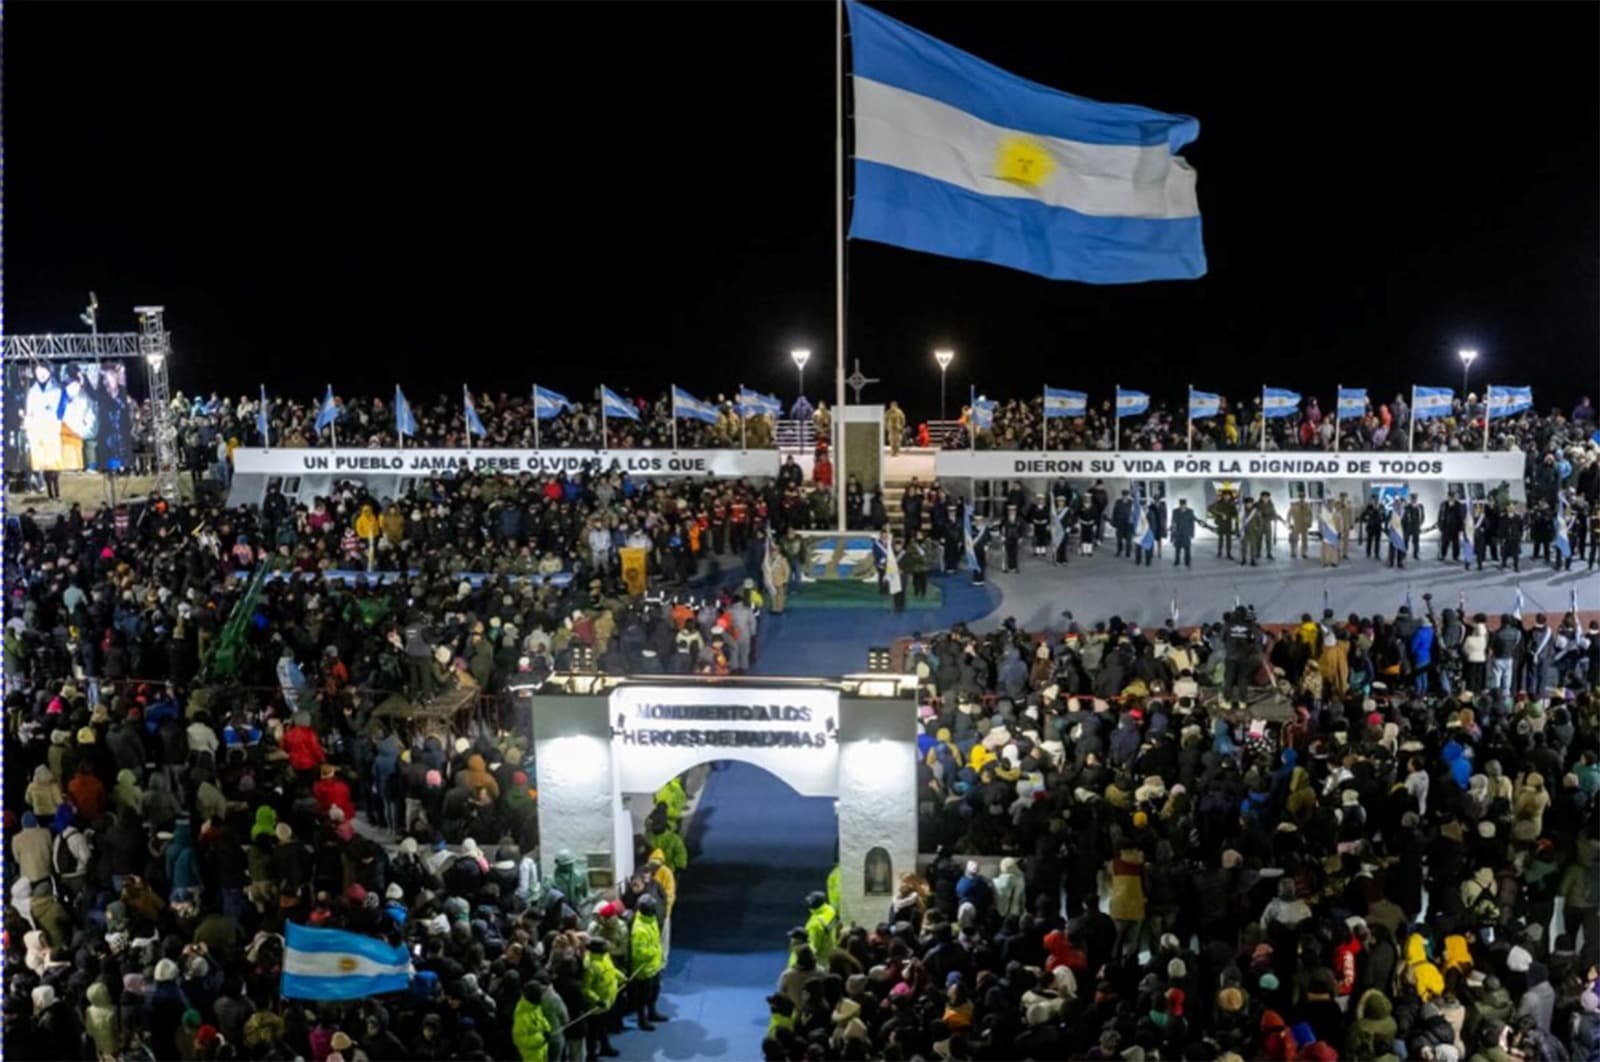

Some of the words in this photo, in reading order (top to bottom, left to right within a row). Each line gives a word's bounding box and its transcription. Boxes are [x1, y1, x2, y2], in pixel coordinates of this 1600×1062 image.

[304, 456, 328, 470] UN
[336, 456, 404, 470] PUEBLO
[410, 456, 468, 470] JAMA
[475, 456, 521, 470] DEBE
[527, 456, 603, 470] OLVIDAR
[610, 456, 622, 471] A
[628, 457, 662, 471] LOS
[668, 457, 705, 471] QUE
[1014, 459, 1083, 473] DIERON
[1090, 459, 1115, 473] SU
[1123, 459, 1166, 473] VIDA
[1174, 459, 1211, 473] POR
[1219, 460, 1241, 473] LA
[1249, 460, 1340, 474] DIGNIDAD
[1347, 460, 1371, 473] DE
[1378, 460, 1443, 474] TODOS
